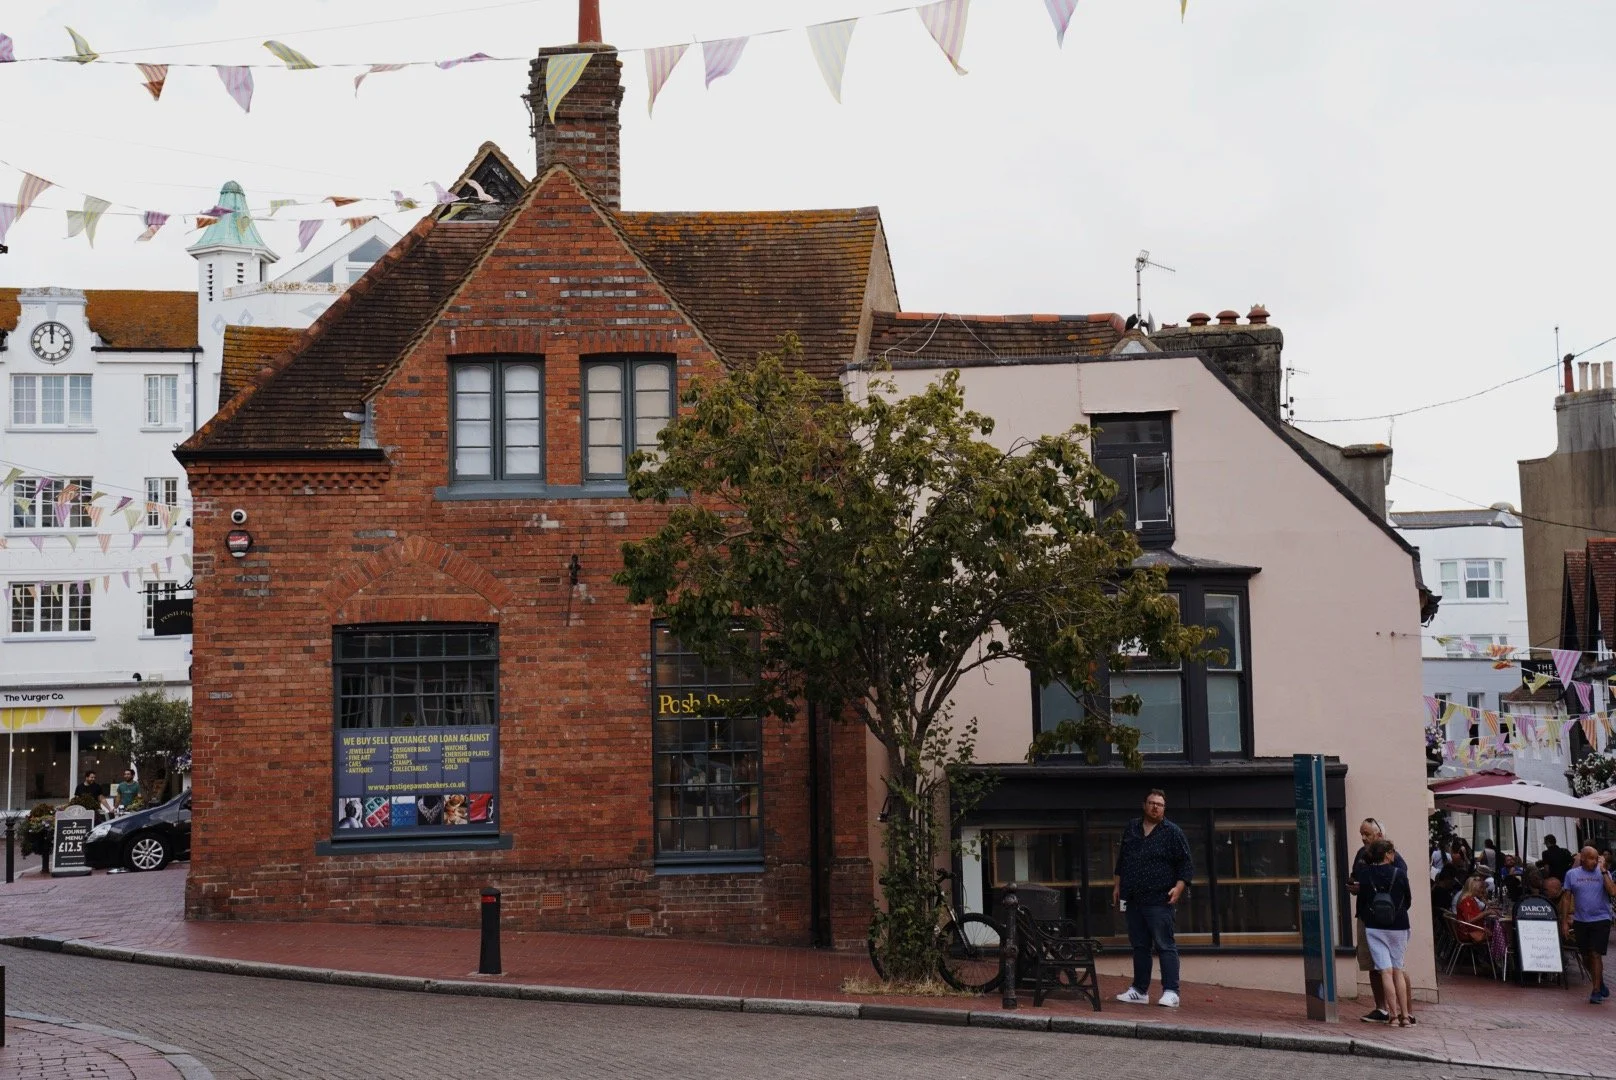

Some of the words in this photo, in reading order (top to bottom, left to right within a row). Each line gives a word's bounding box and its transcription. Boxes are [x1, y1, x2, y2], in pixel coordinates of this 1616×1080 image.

[20, 694, 50, 702] Vurger
[659, 694, 700, 714] Posh
[344, 738, 355, 746] WE
[356, 737, 372, 745] BUY
[372, 736, 388, 744] SELL
[390, 735, 427, 744] EXCHANGE
[428, 734, 438, 743] OR
[440, 734, 458, 742] LOAN
[460, 734, 490, 742] AGAINST
[368, 782, 466, 791] www.prestigepawnbrokers.co.uk
